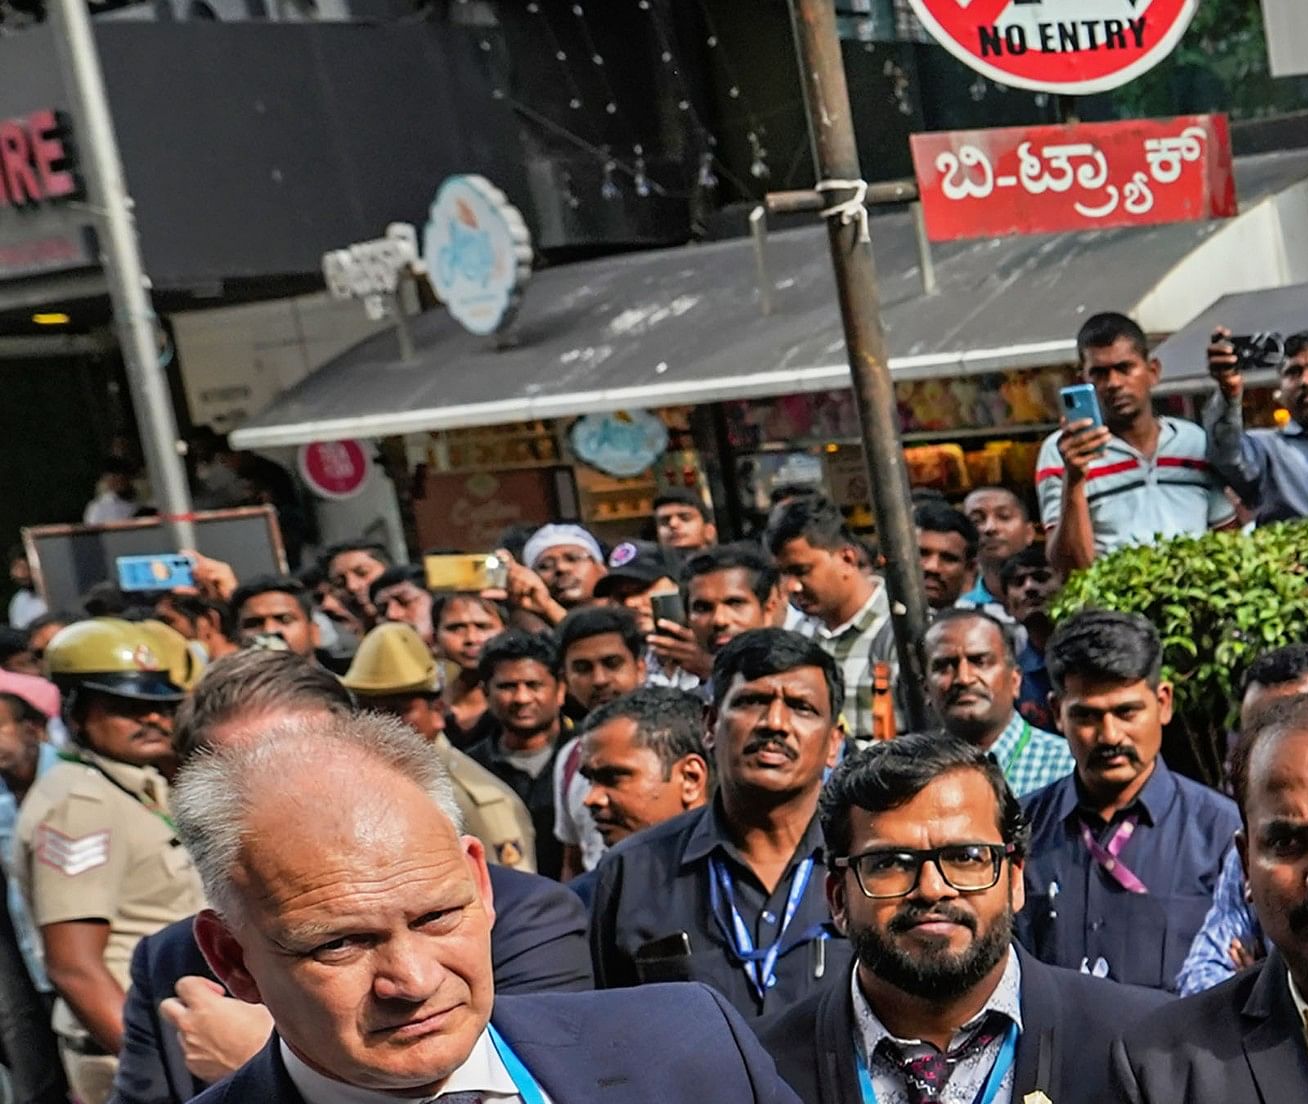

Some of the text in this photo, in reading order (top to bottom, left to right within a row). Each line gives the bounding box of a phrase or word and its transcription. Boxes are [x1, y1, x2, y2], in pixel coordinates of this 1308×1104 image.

[978, 17, 1147, 57] NO ENTRY
[0, 109, 75, 207] RE
